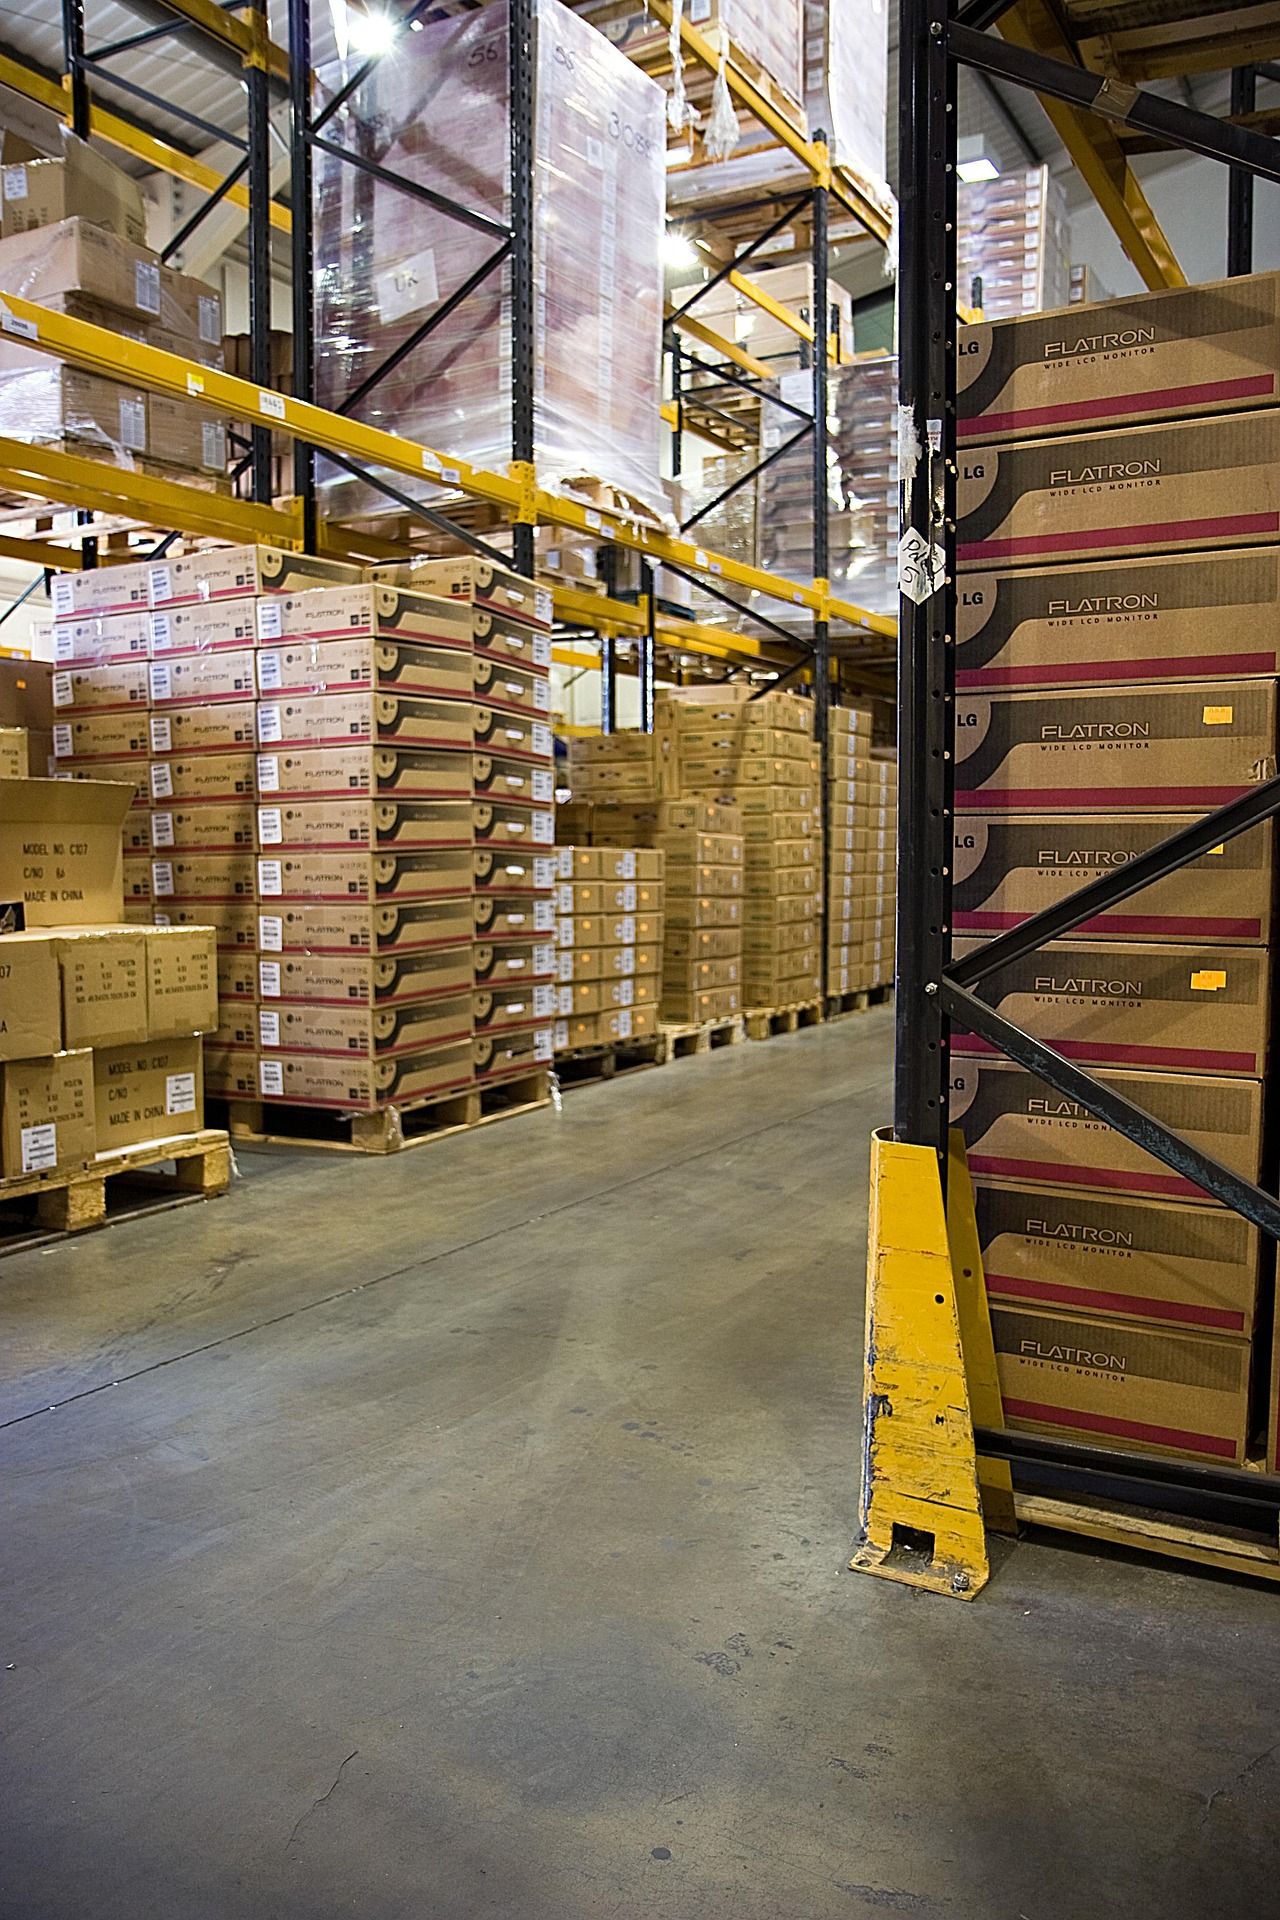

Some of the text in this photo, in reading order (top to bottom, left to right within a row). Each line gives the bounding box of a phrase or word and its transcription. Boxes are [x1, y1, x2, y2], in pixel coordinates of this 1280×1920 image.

[958, 341, 979, 356] LG
[1044, 327, 1155, 358] FLATRON
[1044, 347, 1155, 370] WIDE LCD MONITOR
[964, 466, 984, 479] LG
[1050, 459, 1161, 485] FLATRON
[1050, 479, 1161, 497] WIDE LCD MONITOR
[962, 592, 983, 606] LG
[1048, 593, 1158, 614] FLATRON
[1048, 613, 1159, 627] WIDE LCD MONITOR
[957, 714, 977, 727] LG
[1041, 722, 1149, 739] FLATRON
[1073, 743, 1092, 751] LCD
[23, 843, 48, 856] MODEL
[954, 835, 975, 848] LG
[24, 890, 84, 902] MADE IN CHINA
[1034, 977, 1142, 995] FLATRON
[1092, 999, 1142, 1008] MONITOR
[108, 1062, 132, 1075] MODEL
[109, 1104, 164, 1125] MADE IN CHINA
[1028, 1098, 1090, 1116] FLAT
[1027, 1117, 1052, 1126] WIDE
[1059, 1120, 1078, 1129] LCD
[1026, 1219, 1132, 1245] FLATRON
[1025, 1238, 1132, 1258] WIDE LCD MONITOR
[1020, 1340, 1126, 1370] FLATRON
[1019, 1358, 1126, 1382] WIDE LCD MONITOR
